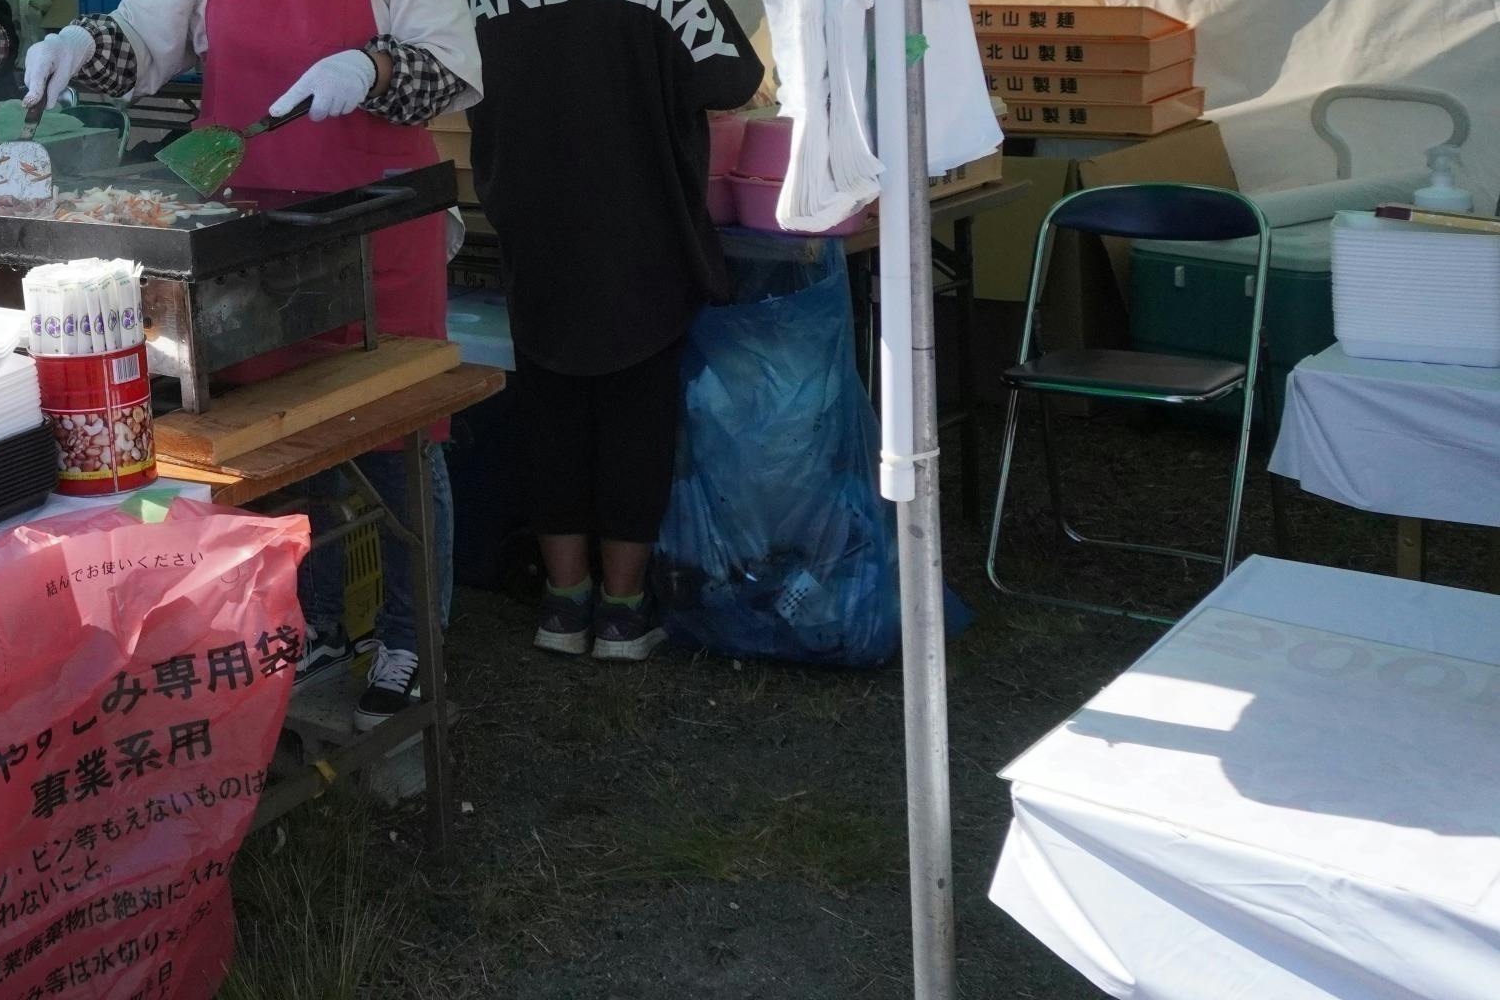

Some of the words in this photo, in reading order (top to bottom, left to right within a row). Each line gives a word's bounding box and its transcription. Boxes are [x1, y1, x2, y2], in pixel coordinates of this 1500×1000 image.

[976, 9, 1076, 29] 北山製麺
[986, 43, 1084, 63] 北山製麺
[1002, 105, 1088, 125] 山製麺
[45, 550, 204, 598] 結んでお使いください
[30, 718, 213, 820] 事業系用
